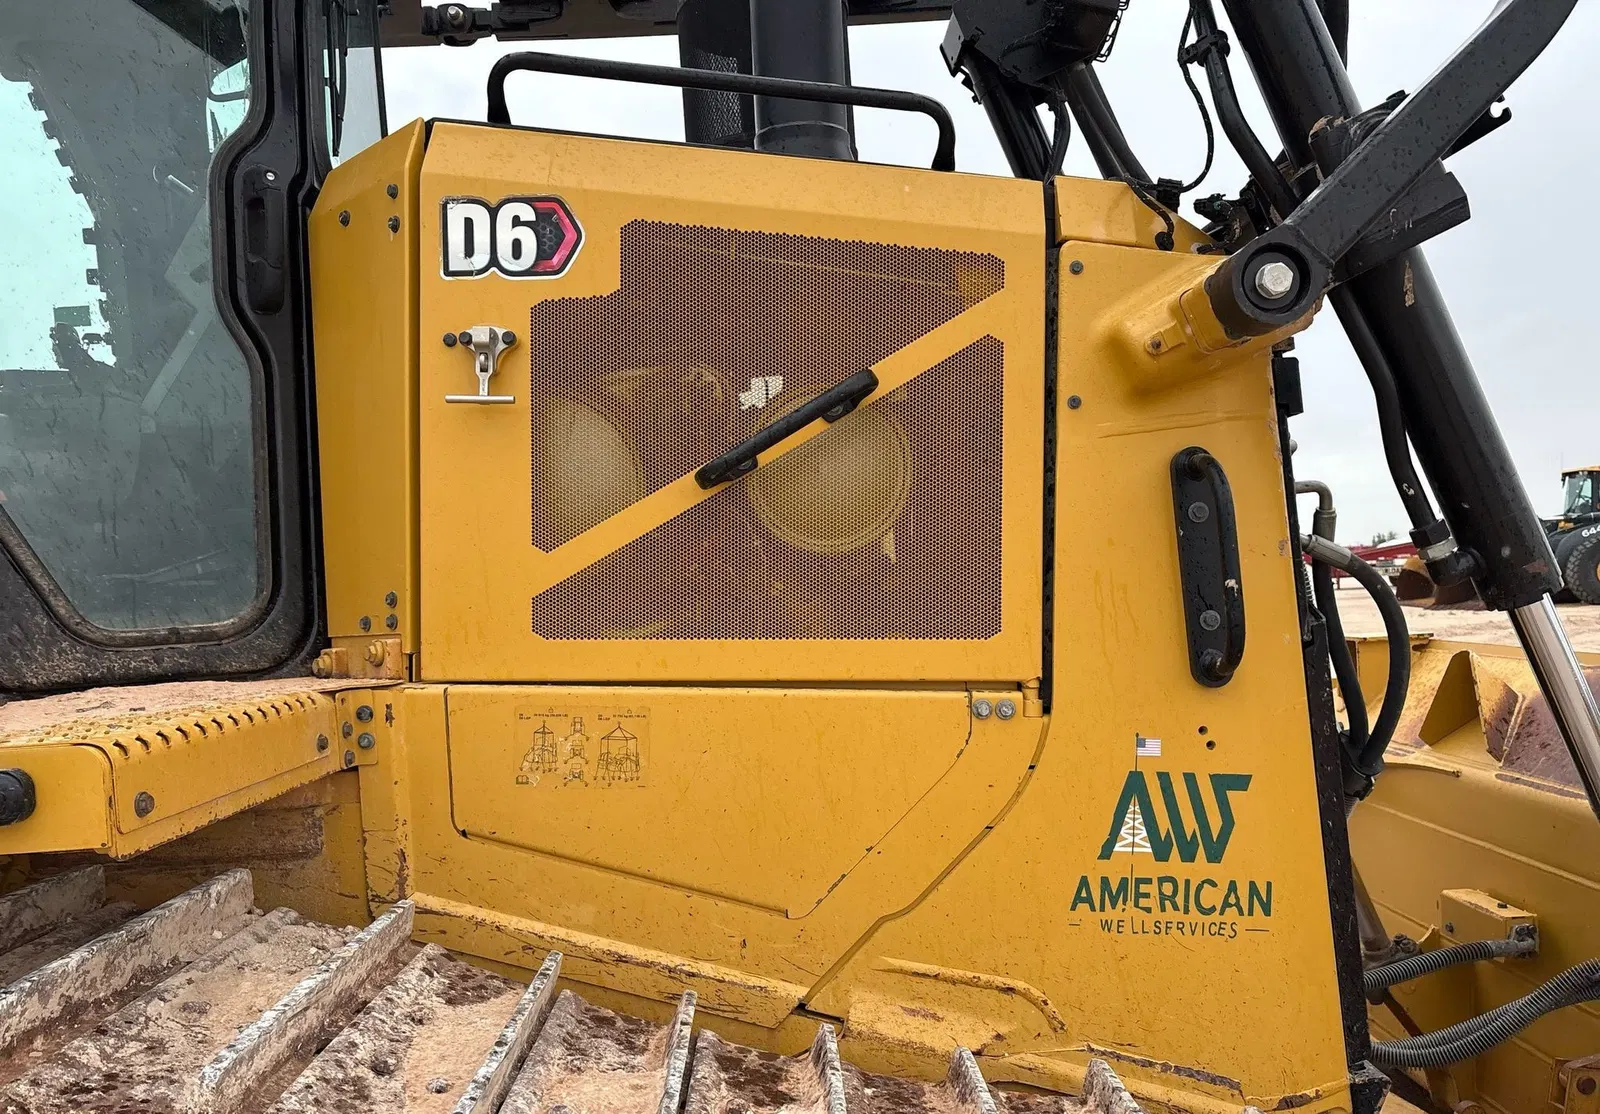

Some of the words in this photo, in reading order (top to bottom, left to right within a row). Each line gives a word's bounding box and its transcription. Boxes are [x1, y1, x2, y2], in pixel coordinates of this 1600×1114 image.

[446, 201, 538, 272] D6
[1097, 770, 1253, 864] AWS
[1069, 875, 1273, 917] AMERICAN
